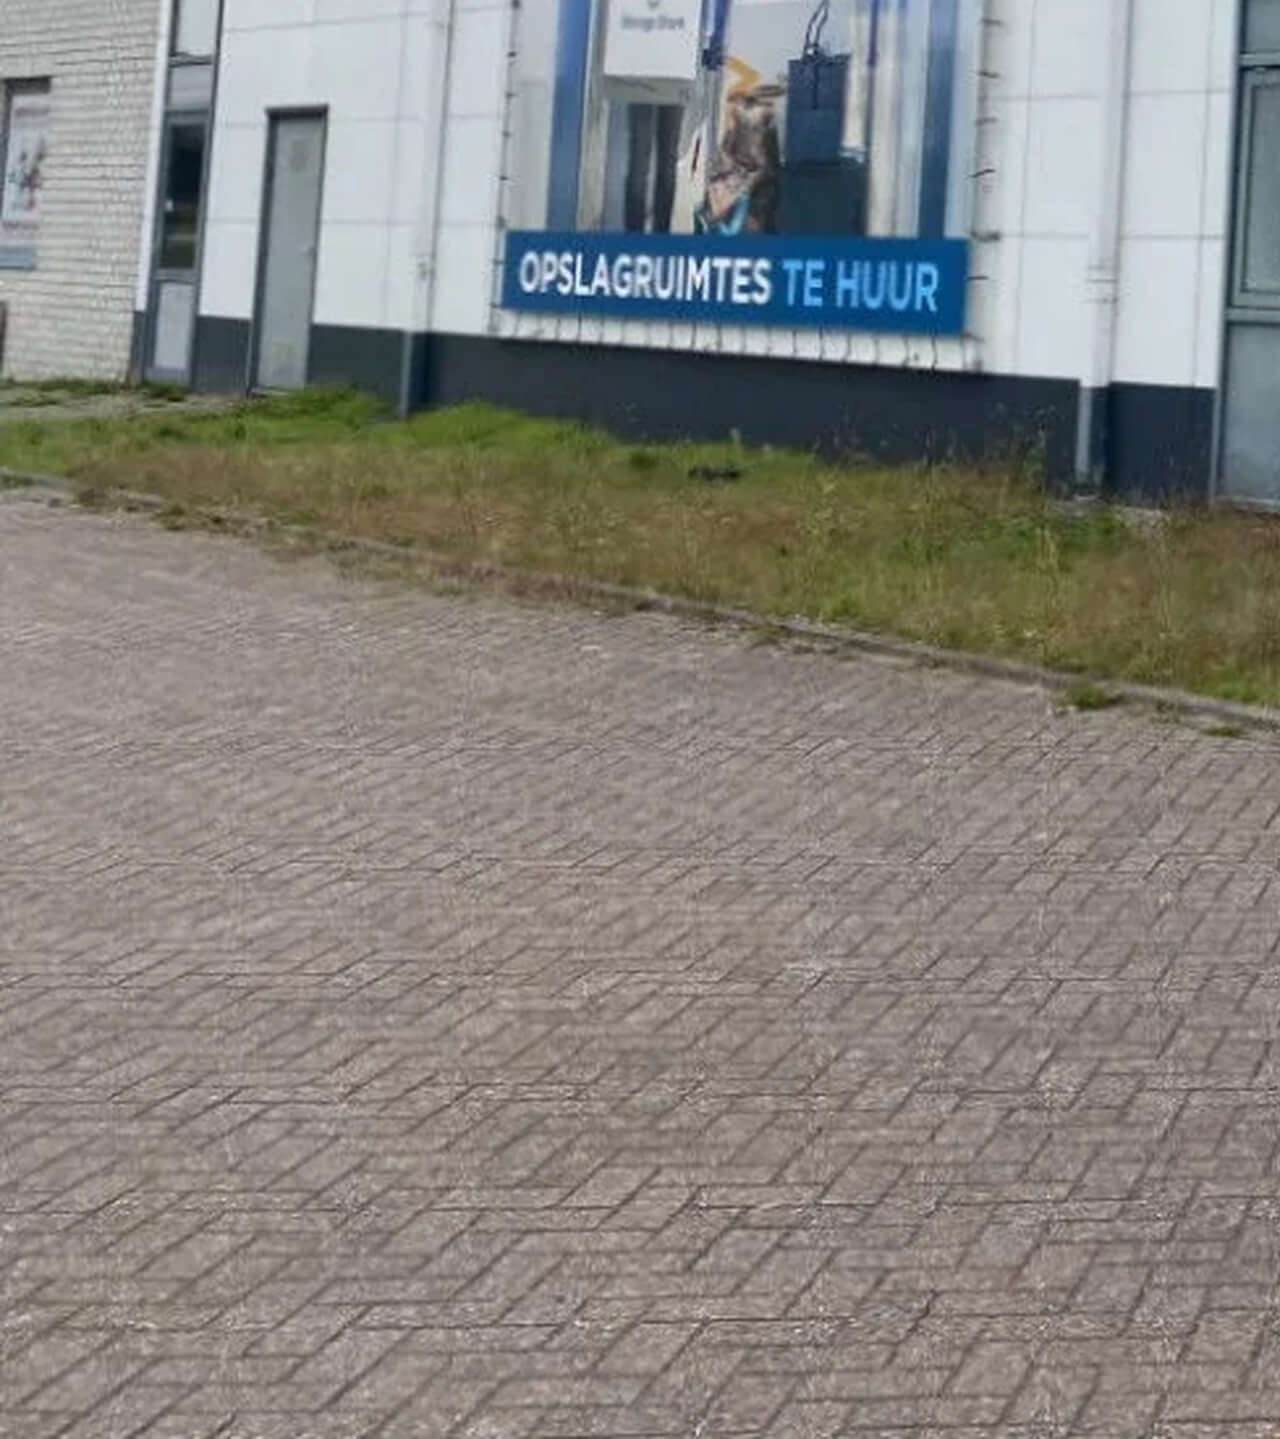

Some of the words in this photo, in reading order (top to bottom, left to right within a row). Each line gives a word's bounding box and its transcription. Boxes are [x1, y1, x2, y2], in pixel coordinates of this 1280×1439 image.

[518, 250, 772, 307] OPSLAGRUIMTES
[782, 260, 824, 307] TE
[834, 261, 939, 313] HUUR
